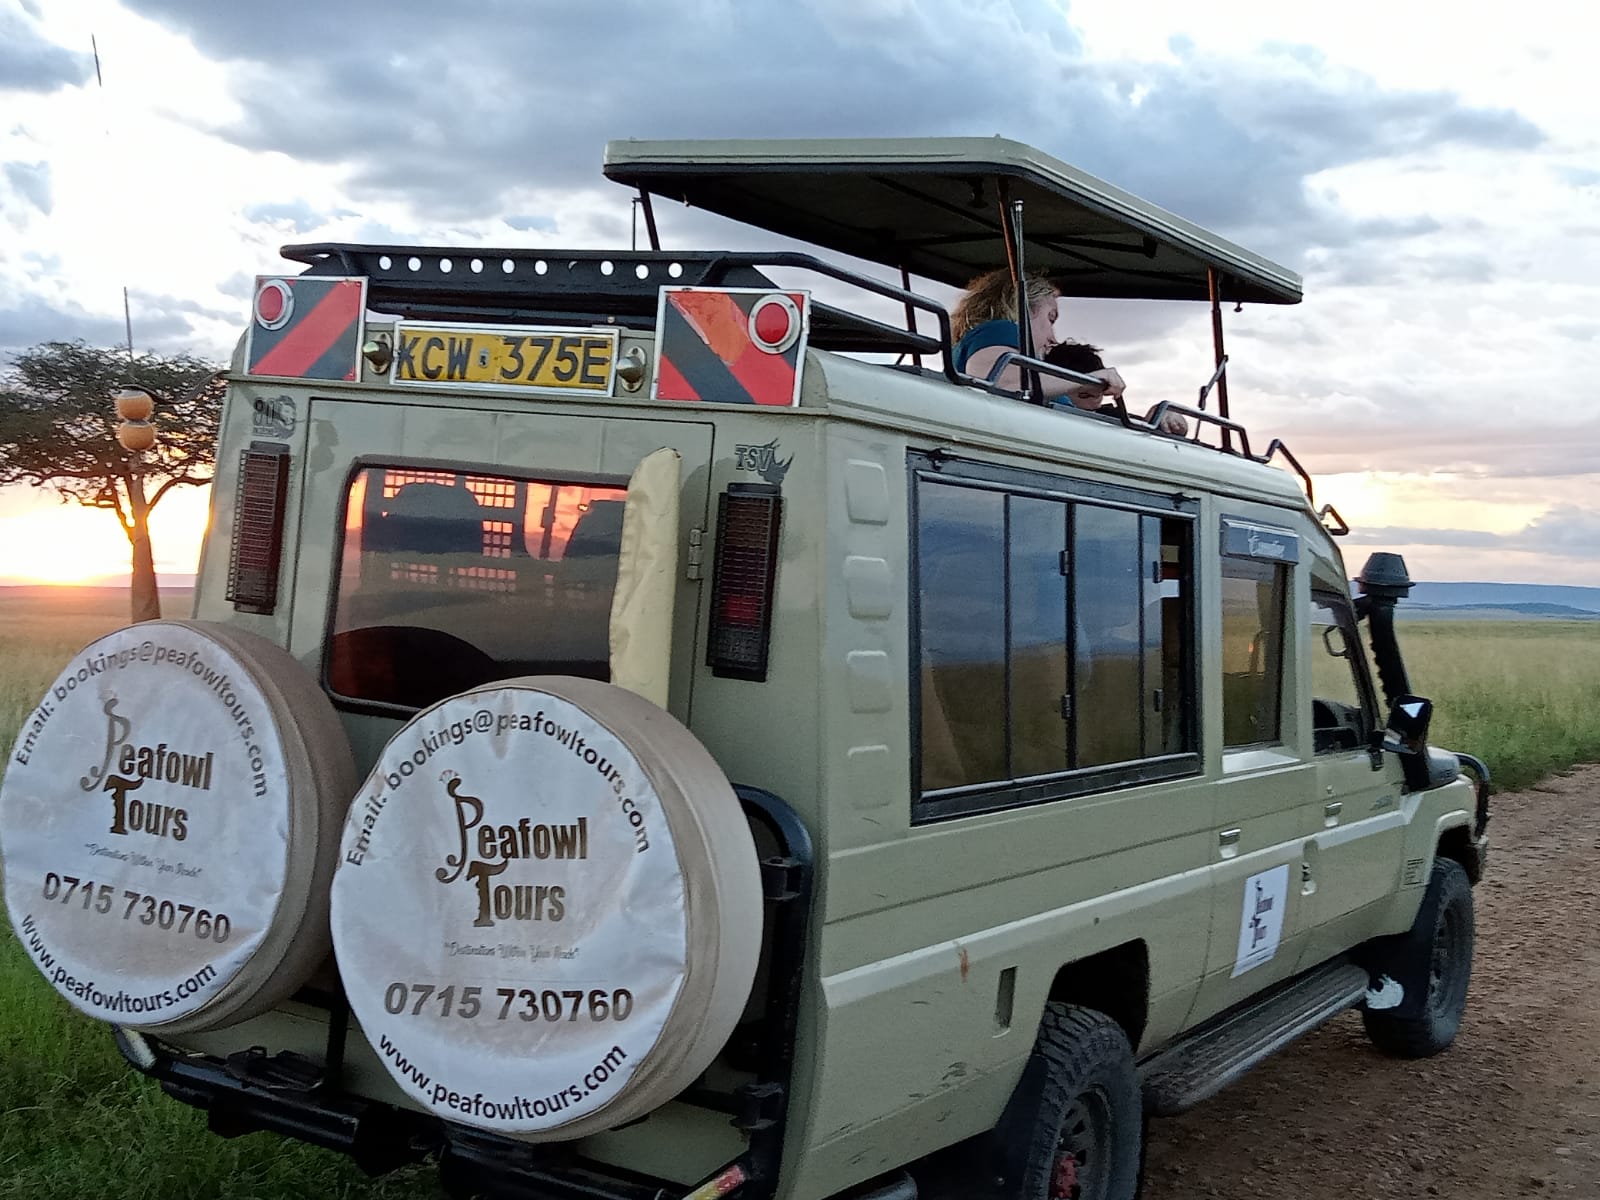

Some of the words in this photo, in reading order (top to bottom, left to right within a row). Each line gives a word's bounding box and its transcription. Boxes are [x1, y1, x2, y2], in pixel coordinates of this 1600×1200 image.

[398, 333, 473, 380] KCW
[501, 335, 612, 385] 375E
[735, 444, 774, 472] TSV
[15, 701, 55, 767] Email:
[53, 640, 268, 798] bookings@peafowltours.com
[79, 698, 215, 792] Peafowl
[103, 774, 189, 841] Tours
[384, 709, 650, 854] bookings@peafowltours.com
[435, 777, 588, 884] Peafowl
[42, 872, 114, 914] 0715
[123, 890, 231, 944] 730760
[466, 858, 566, 928] Tours
[21, 914, 218, 1013] www.peafowltours.com
[384, 982, 482, 1019] 0715
[496, 987, 633, 1022] 730760
[379, 1034, 627, 1120] www.peafowltours.com
